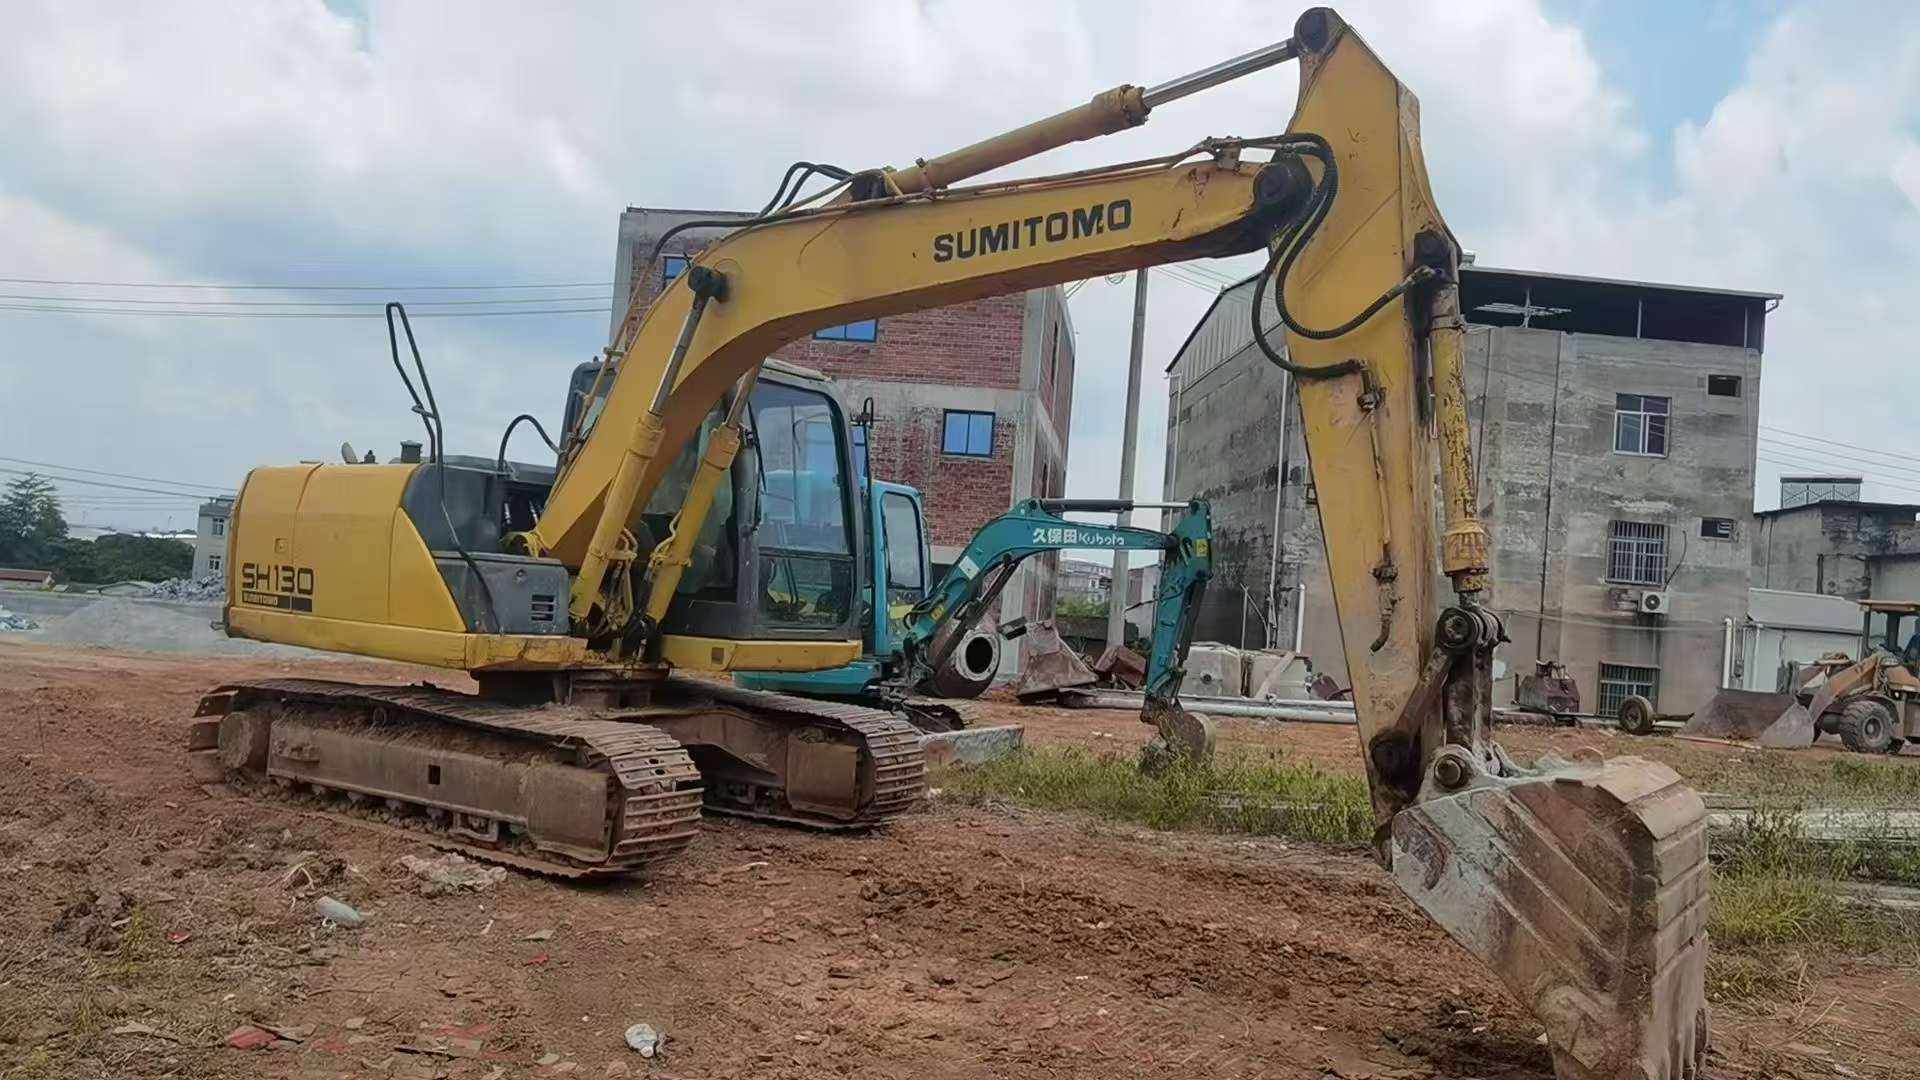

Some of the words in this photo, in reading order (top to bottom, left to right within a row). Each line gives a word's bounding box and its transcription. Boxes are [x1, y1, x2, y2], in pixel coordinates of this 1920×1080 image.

[933, 199, 1132, 263] SUMITOMO
[1033, 528, 1077, 544] 久保田
[1078, 532, 1125, 546] Kubota
[242, 562, 314, 595] SH130
